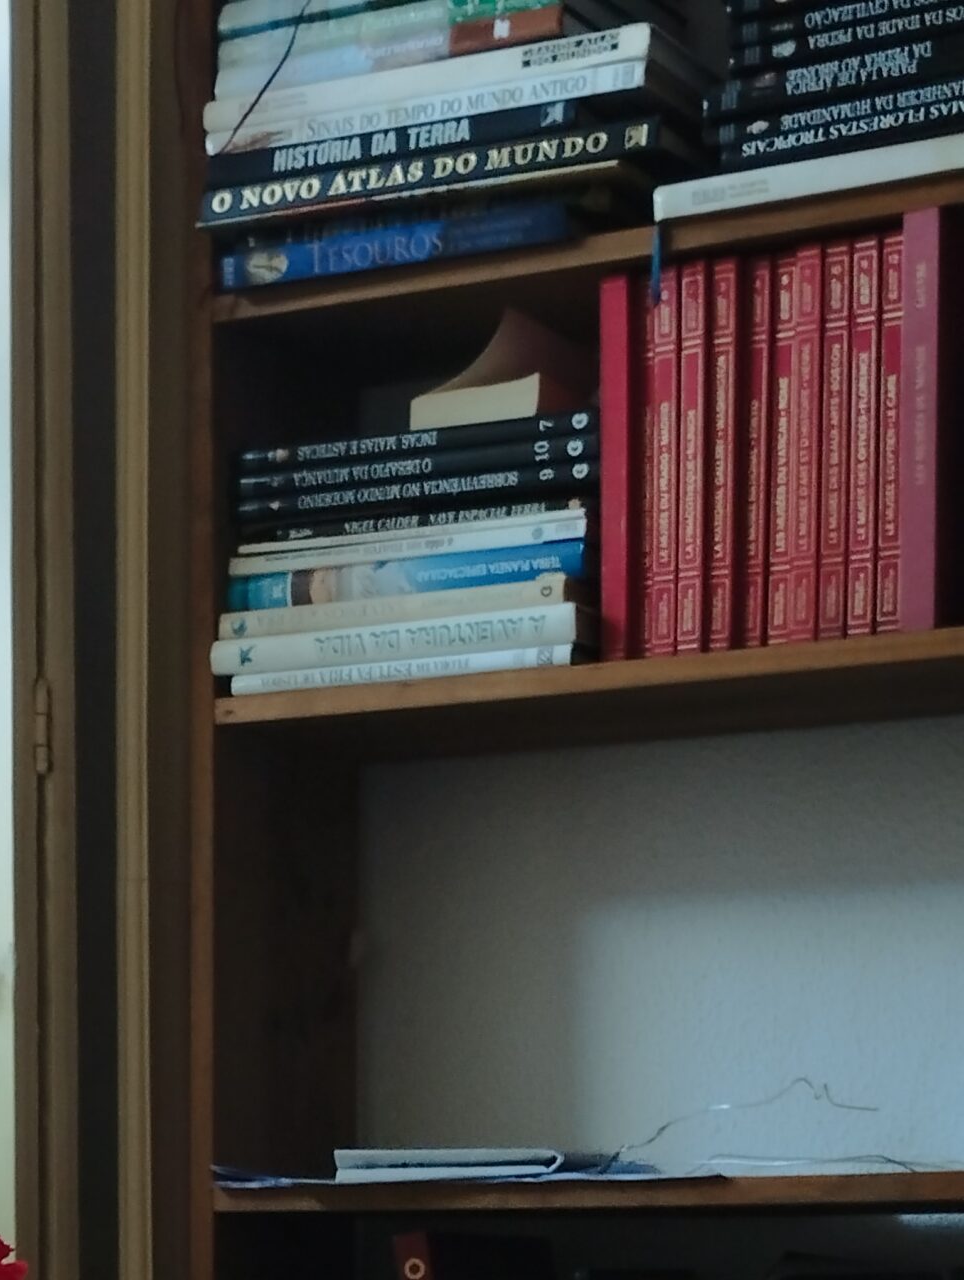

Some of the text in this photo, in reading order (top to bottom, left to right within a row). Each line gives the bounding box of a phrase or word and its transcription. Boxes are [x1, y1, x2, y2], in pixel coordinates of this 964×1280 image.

[307, 74, 588, 139] SINAIS DO TEMPO DO MUNDO ANTIGO
[778, 99, 873, 130] HUMANIDADE
[874, 95, 894, 112] DA
[370, 129, 397, 157] DA
[407, 118, 471, 151] TERRA
[740, 107, 927, 157] FLORESTAS TROPICAIS
[211, 129, 609, 214] O NOVO ATLAS DO MUNDO
[311, 228, 444, 276] TESOUROS
[296, 441, 348, 461] ASTECAS
[349, 441, 358, 455] E
[359, 436, 397, 453] MAIAS
[293, 458, 432, 486] O DESAFIO DA MUDANÇA
[297, 471, 519, 509] SOBREVIVÊNCIA NO MUNDO MODERNO
[488, 558, 529, 576] PLANETA
[531, 554, 561, 572] TERRA
[313, 614, 546, 660] A AVENTURA DA VIDA
[318, 667, 353, 684] FRIA
[402, 1256, 427, 1280] O
